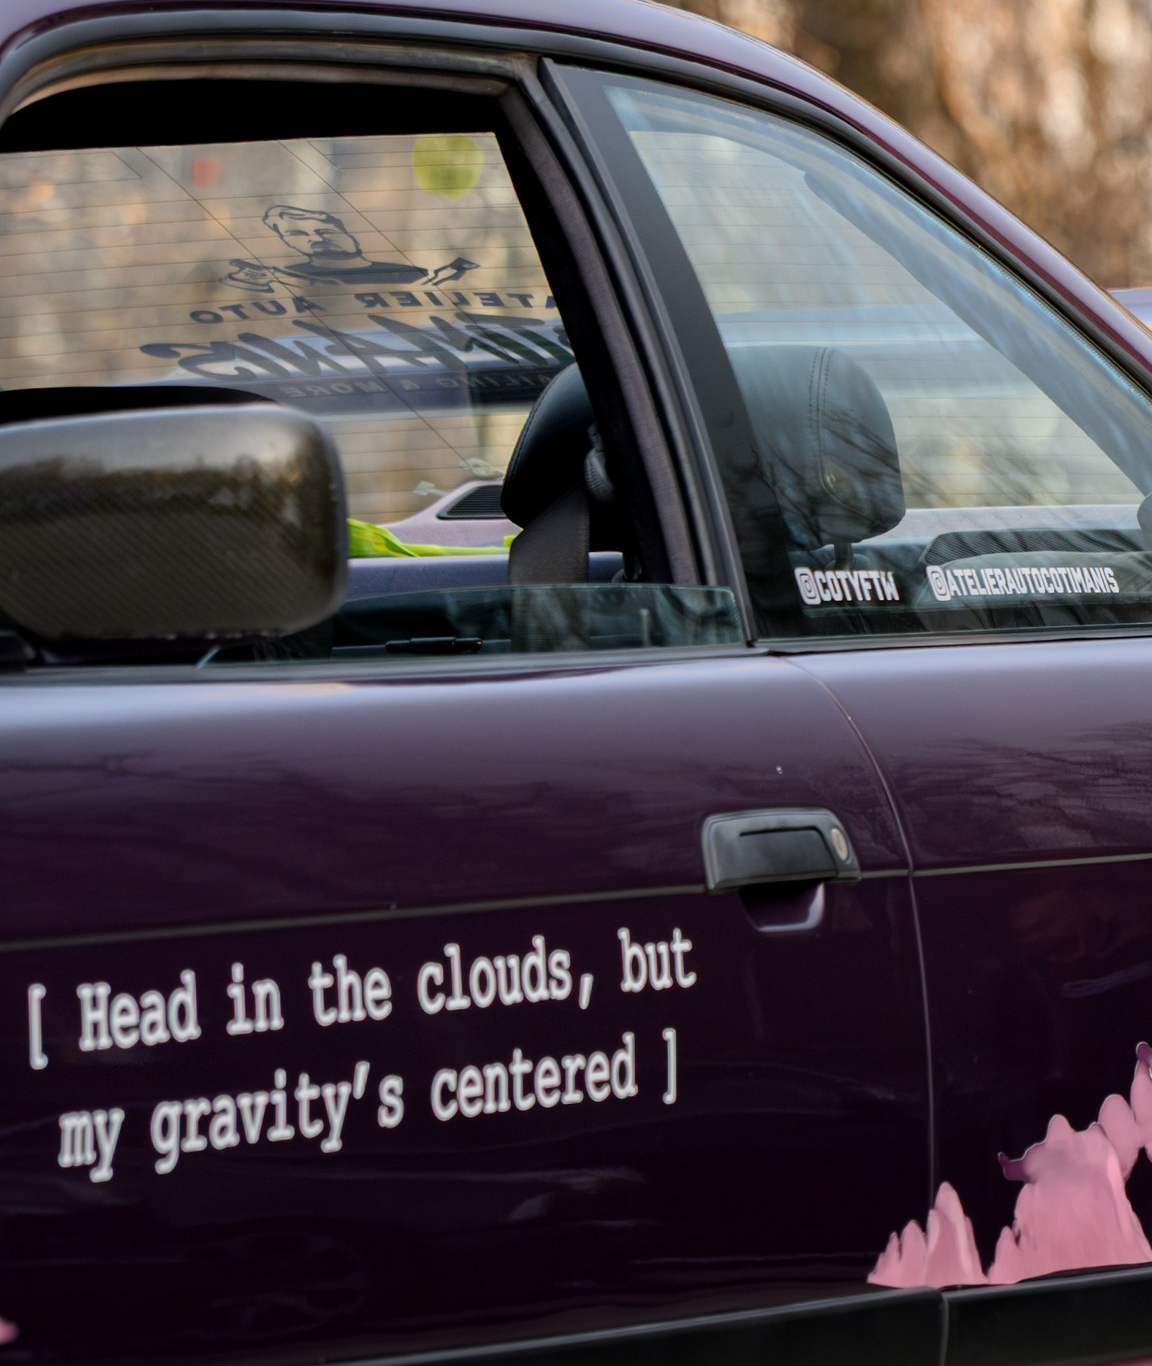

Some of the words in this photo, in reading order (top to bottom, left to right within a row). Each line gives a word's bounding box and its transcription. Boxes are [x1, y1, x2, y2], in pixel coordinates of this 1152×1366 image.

[27, 983, 49, 1070] [
[77, 969, 202, 1052] Head
[226, 962, 285, 1036] in
[307, 953, 393, 1027] the
[417, 934, 594, 1015] clouds,
[617, 927, 697, 993] but
[57, 1107, 126, 1183] my
[150, 1060, 405, 1175] gravity's
[430, 1031, 639, 1122] centered
[662, 1027, 678, 1105] ]
